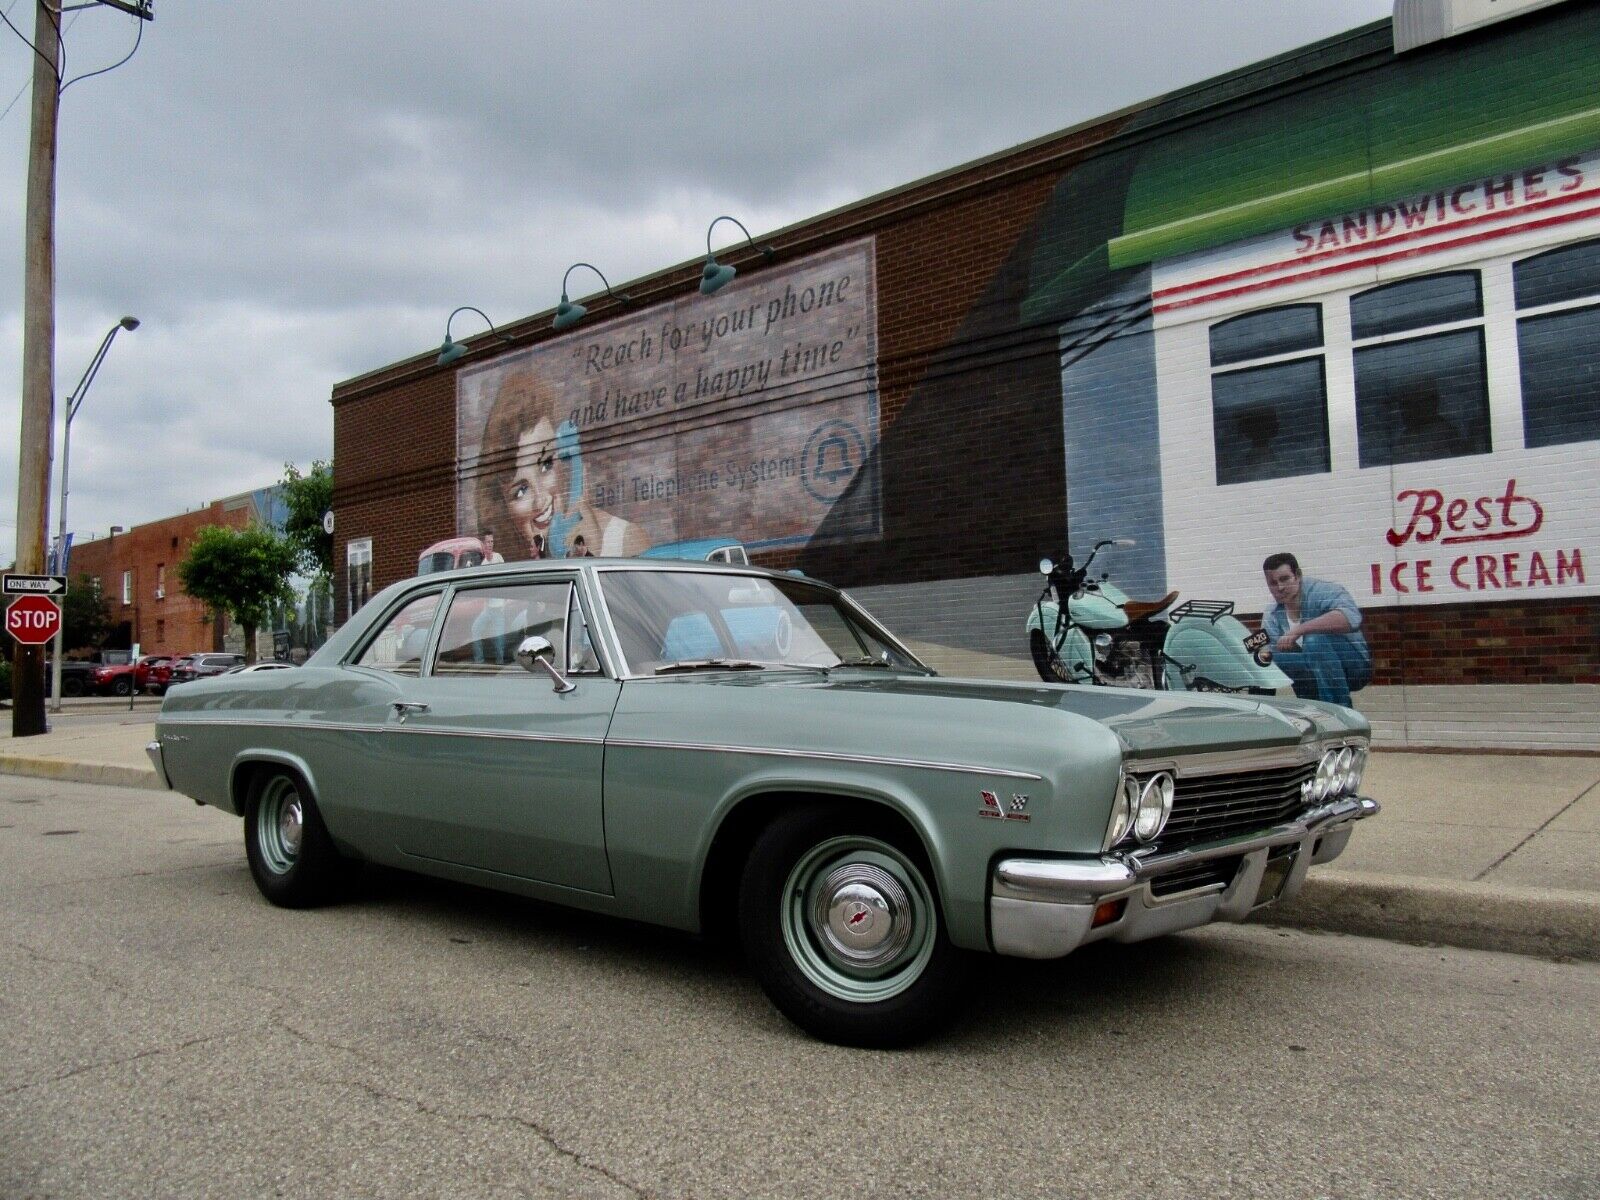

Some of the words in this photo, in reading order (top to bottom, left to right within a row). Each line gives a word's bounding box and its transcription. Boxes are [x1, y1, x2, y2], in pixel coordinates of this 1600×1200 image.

[1292, 155, 1585, 254] SANDWICHES
[657, 321, 696, 364] for
[701, 304, 761, 352] your
[764, 275, 851, 336] phone
[569, 390, 609, 428] and
[614, 388, 668, 418] have
[674, 381, 688, 404] a
[695, 357, 773, 401] happy
[725, 455, 797, 492] System
[1386, 478, 1544, 548] Best
[9, 580, 27, 588] ONE
[30, 580, 48, 589] WAY
[1370, 559, 1435, 595] ICE
[1449, 548, 1586, 592] CREAM
[10, 610, 57, 629] STOP
